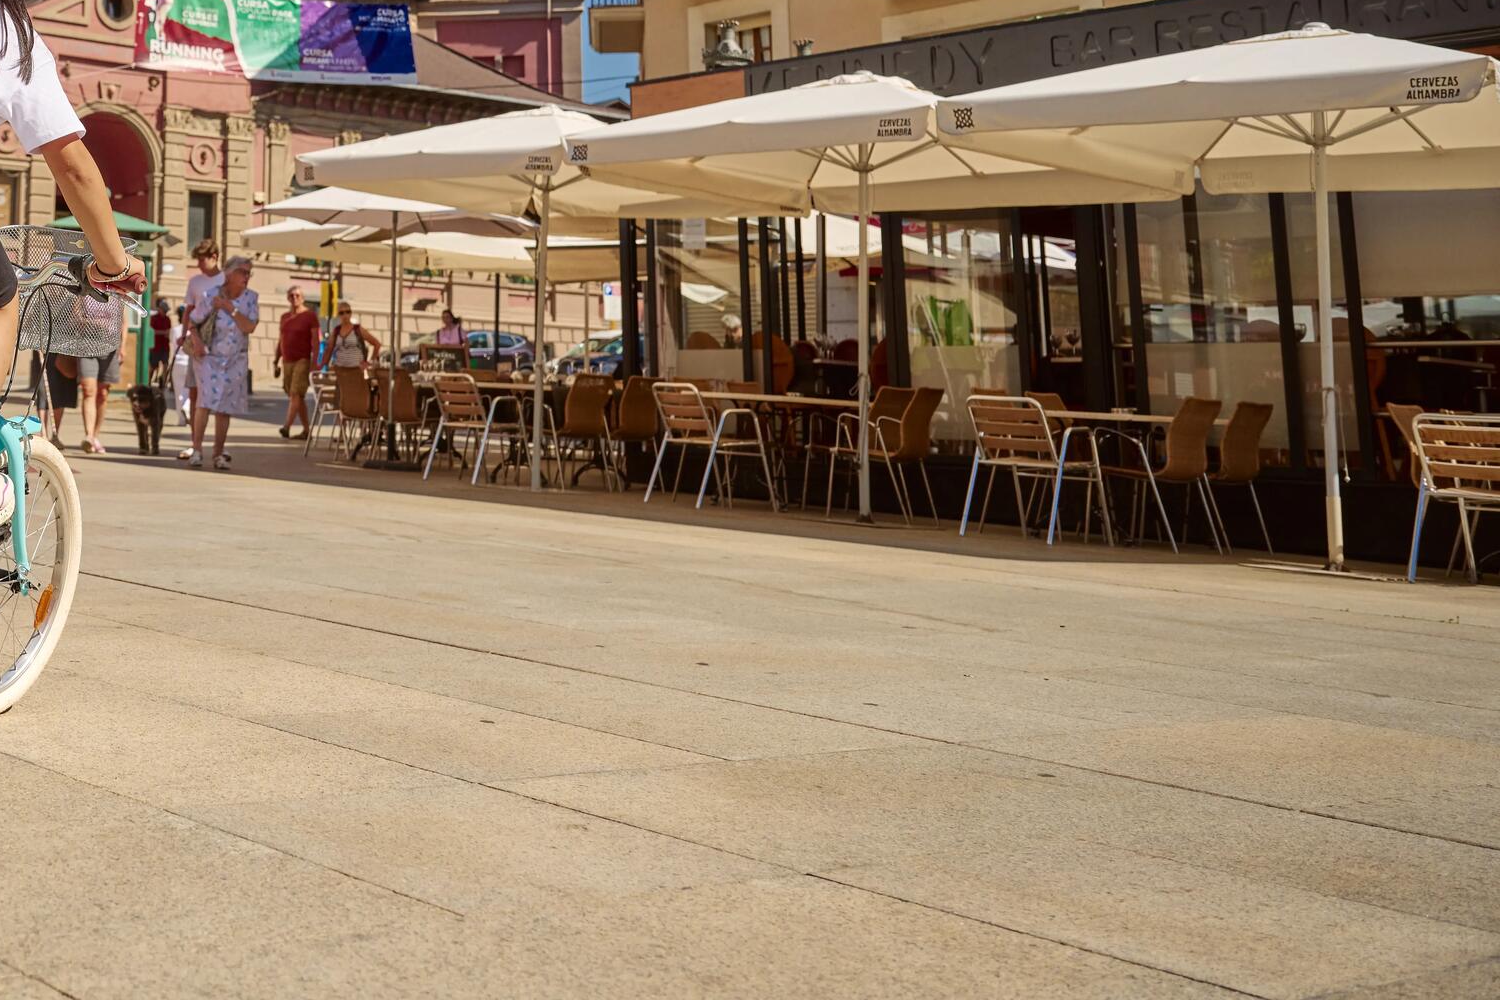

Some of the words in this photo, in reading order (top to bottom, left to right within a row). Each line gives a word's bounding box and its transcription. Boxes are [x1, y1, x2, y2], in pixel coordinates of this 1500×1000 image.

[150, 39, 225, 61] RUNNING
[1050, 25, 1137, 67] BAR
[1410, 76, 1459, 88] CERVEZAS
[1407, 88, 1460, 100] ALHAMBRA
[879, 118, 911, 127] CERVEZAS
[877, 128, 912, 136] ALHAMBRA
